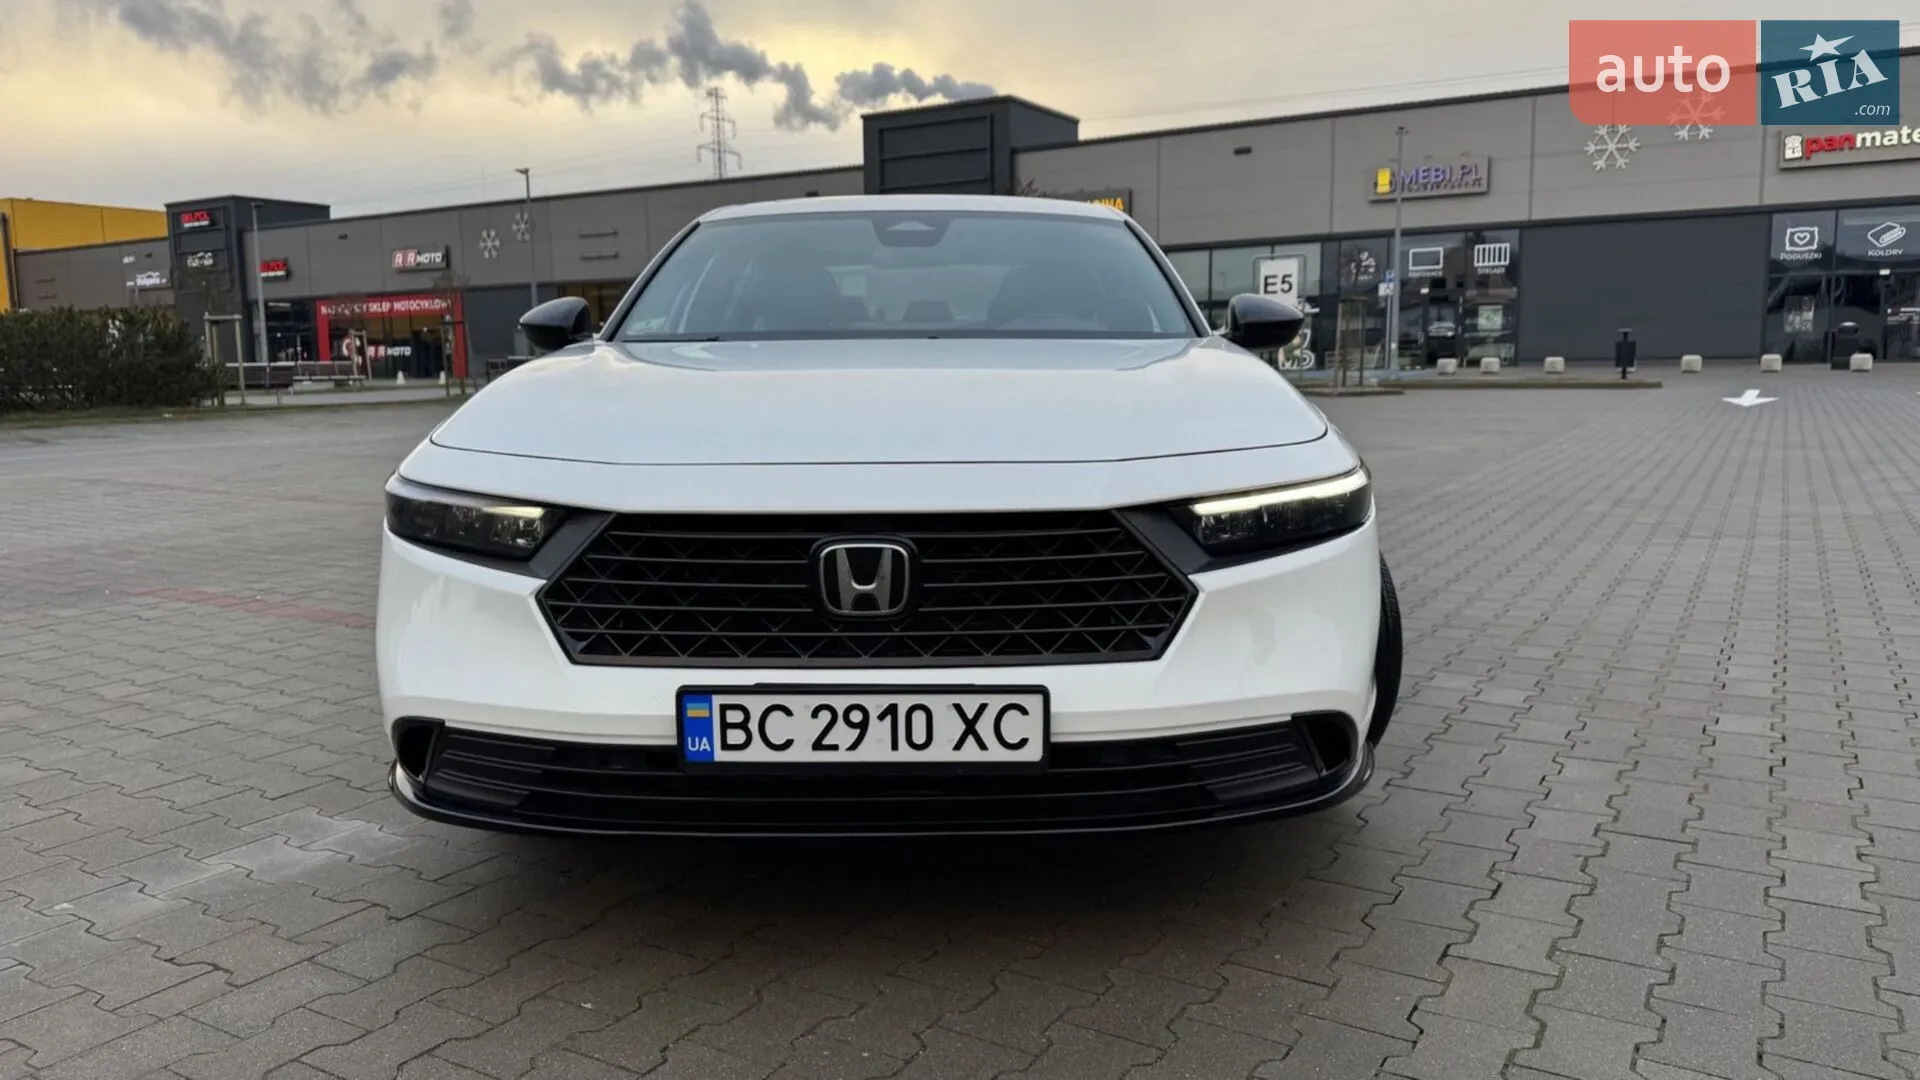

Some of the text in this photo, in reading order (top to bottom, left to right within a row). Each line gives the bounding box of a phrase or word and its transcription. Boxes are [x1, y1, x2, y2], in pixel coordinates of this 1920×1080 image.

[1263, 273, 1293, 294] E5
[688, 702, 1030, 752] UA BC 2910 XC
